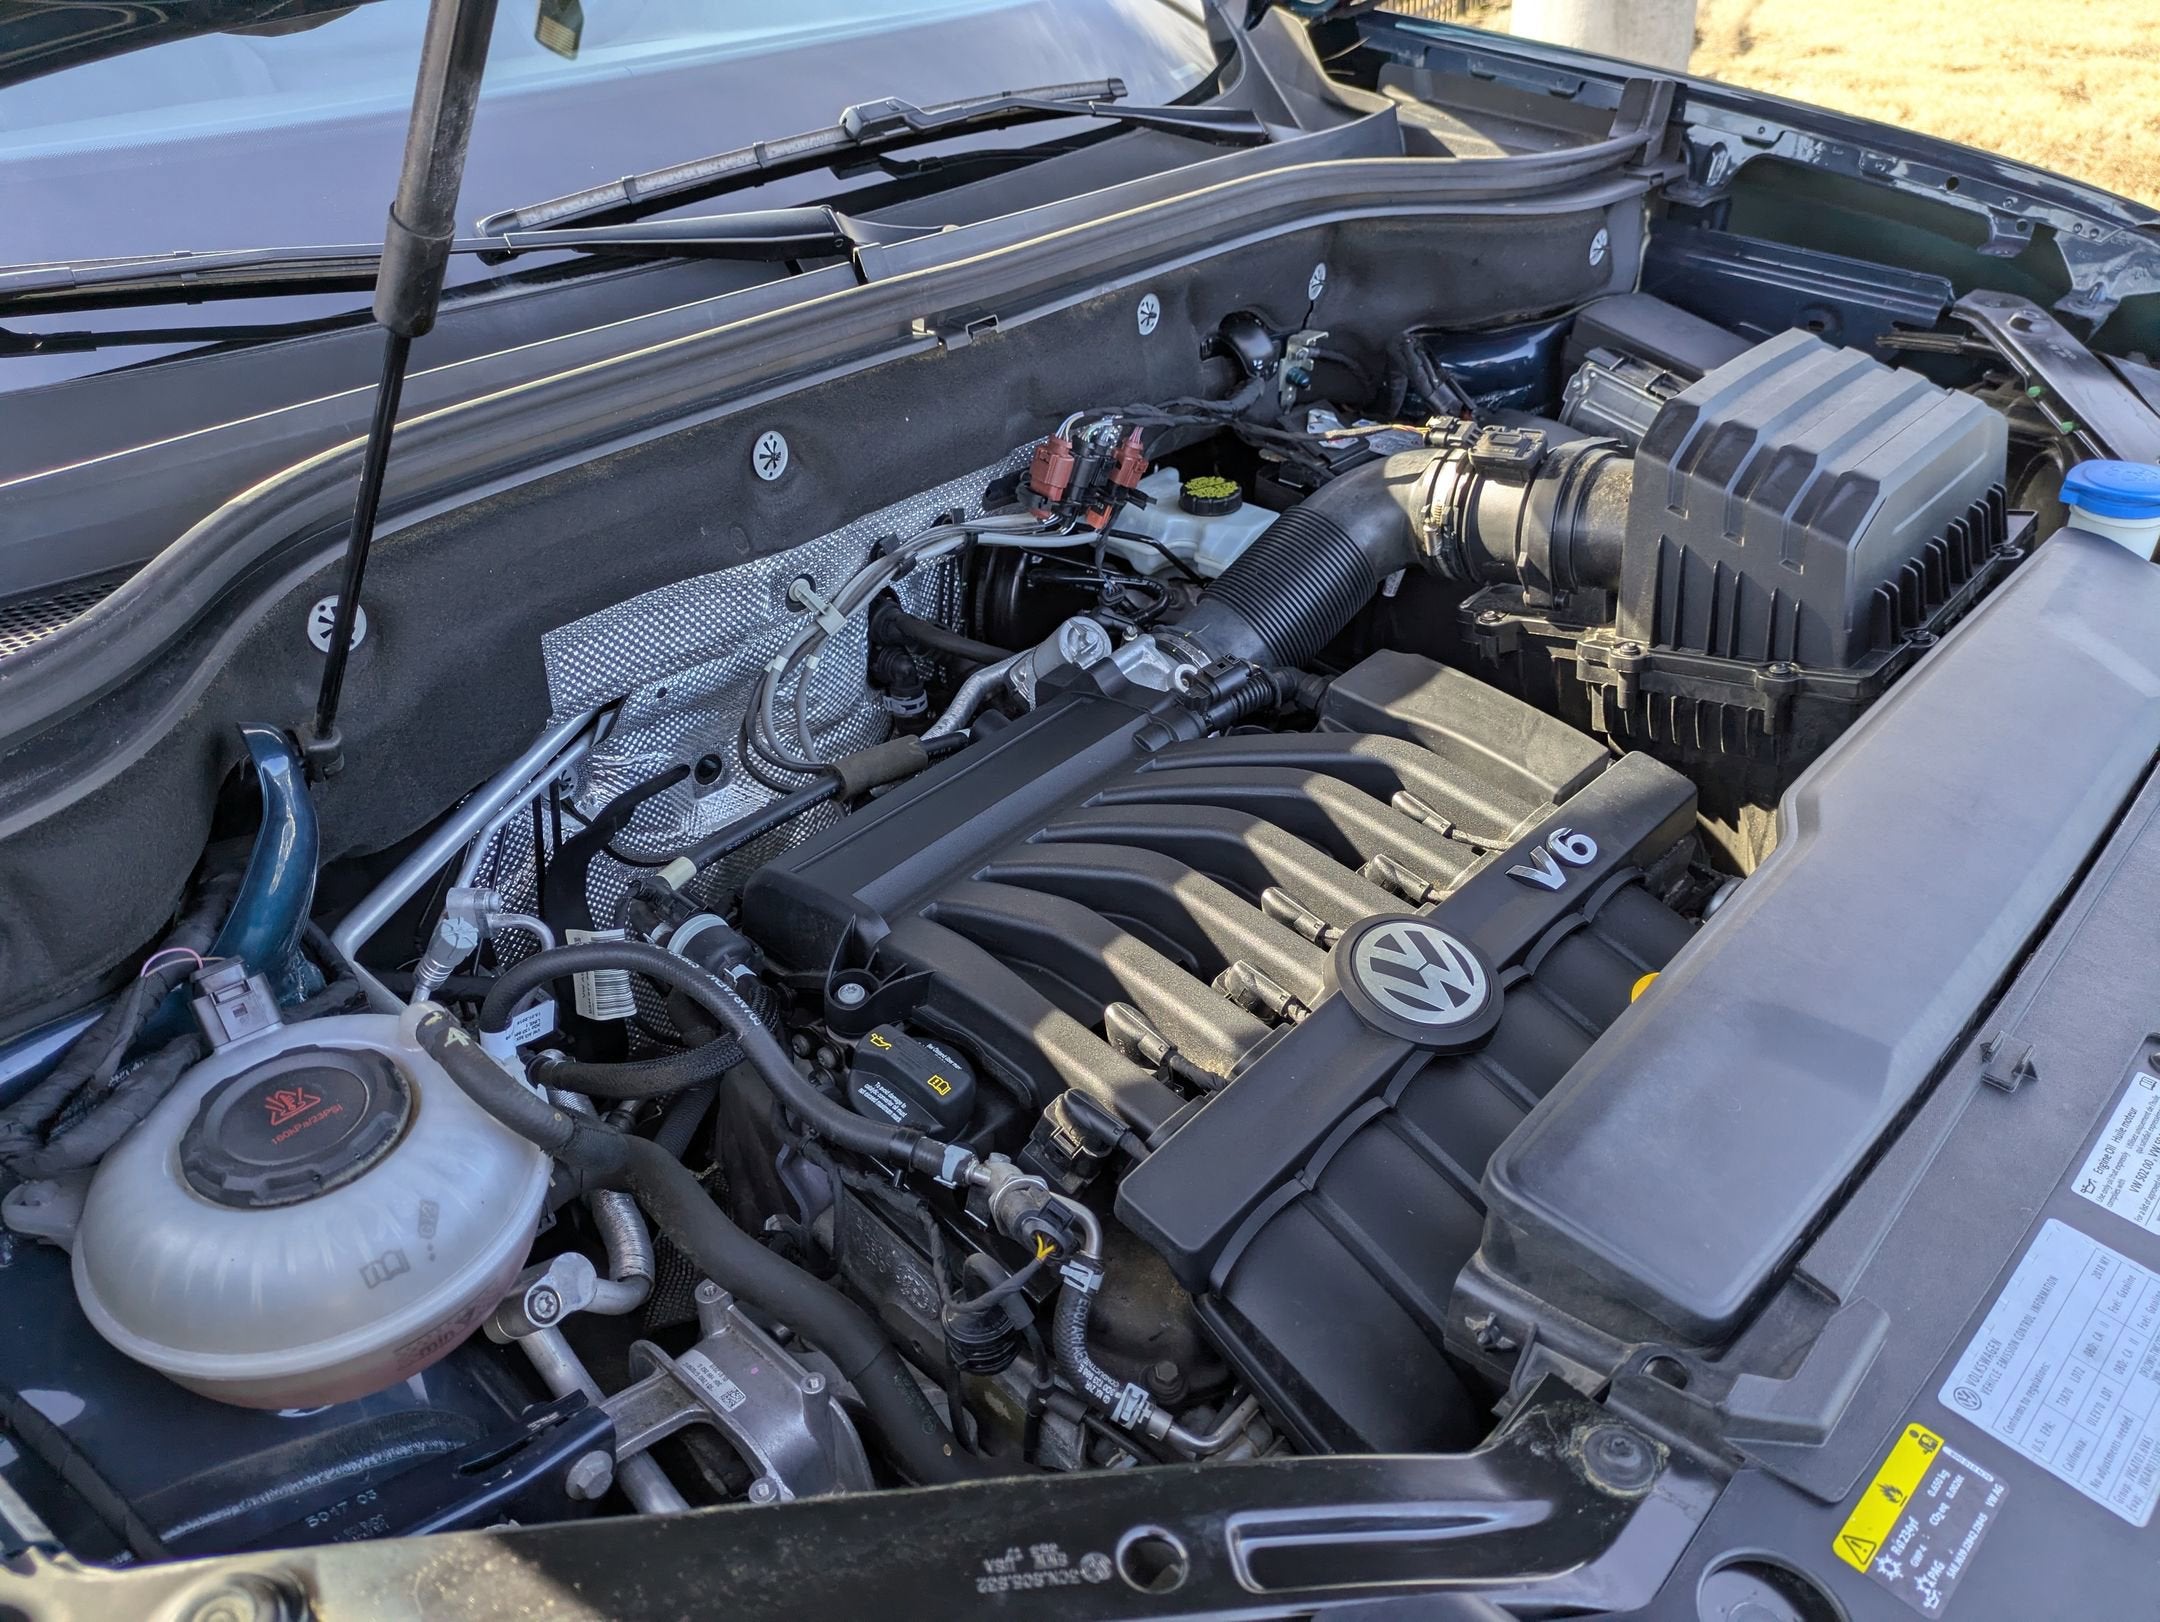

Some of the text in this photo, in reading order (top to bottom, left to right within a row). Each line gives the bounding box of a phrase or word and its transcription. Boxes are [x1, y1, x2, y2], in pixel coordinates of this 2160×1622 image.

[1505, 826, 1598, 891] V6
[2093, 1106, 2138, 1174] Engine Oil Huile moteur
[2128, 1179, 2142, 1193] VW
[2135, 1167, 2149, 1181] 502
[1980, 1274, 2058, 1396] VEHICLE EMISSION CONTROL INFORMATION
[1965, 1336, 2002, 1388] VOLKSWAGEN
[2001, 1401, 2026, 1435] Conforms
[1926, 1558, 1945, 1581] PAG
